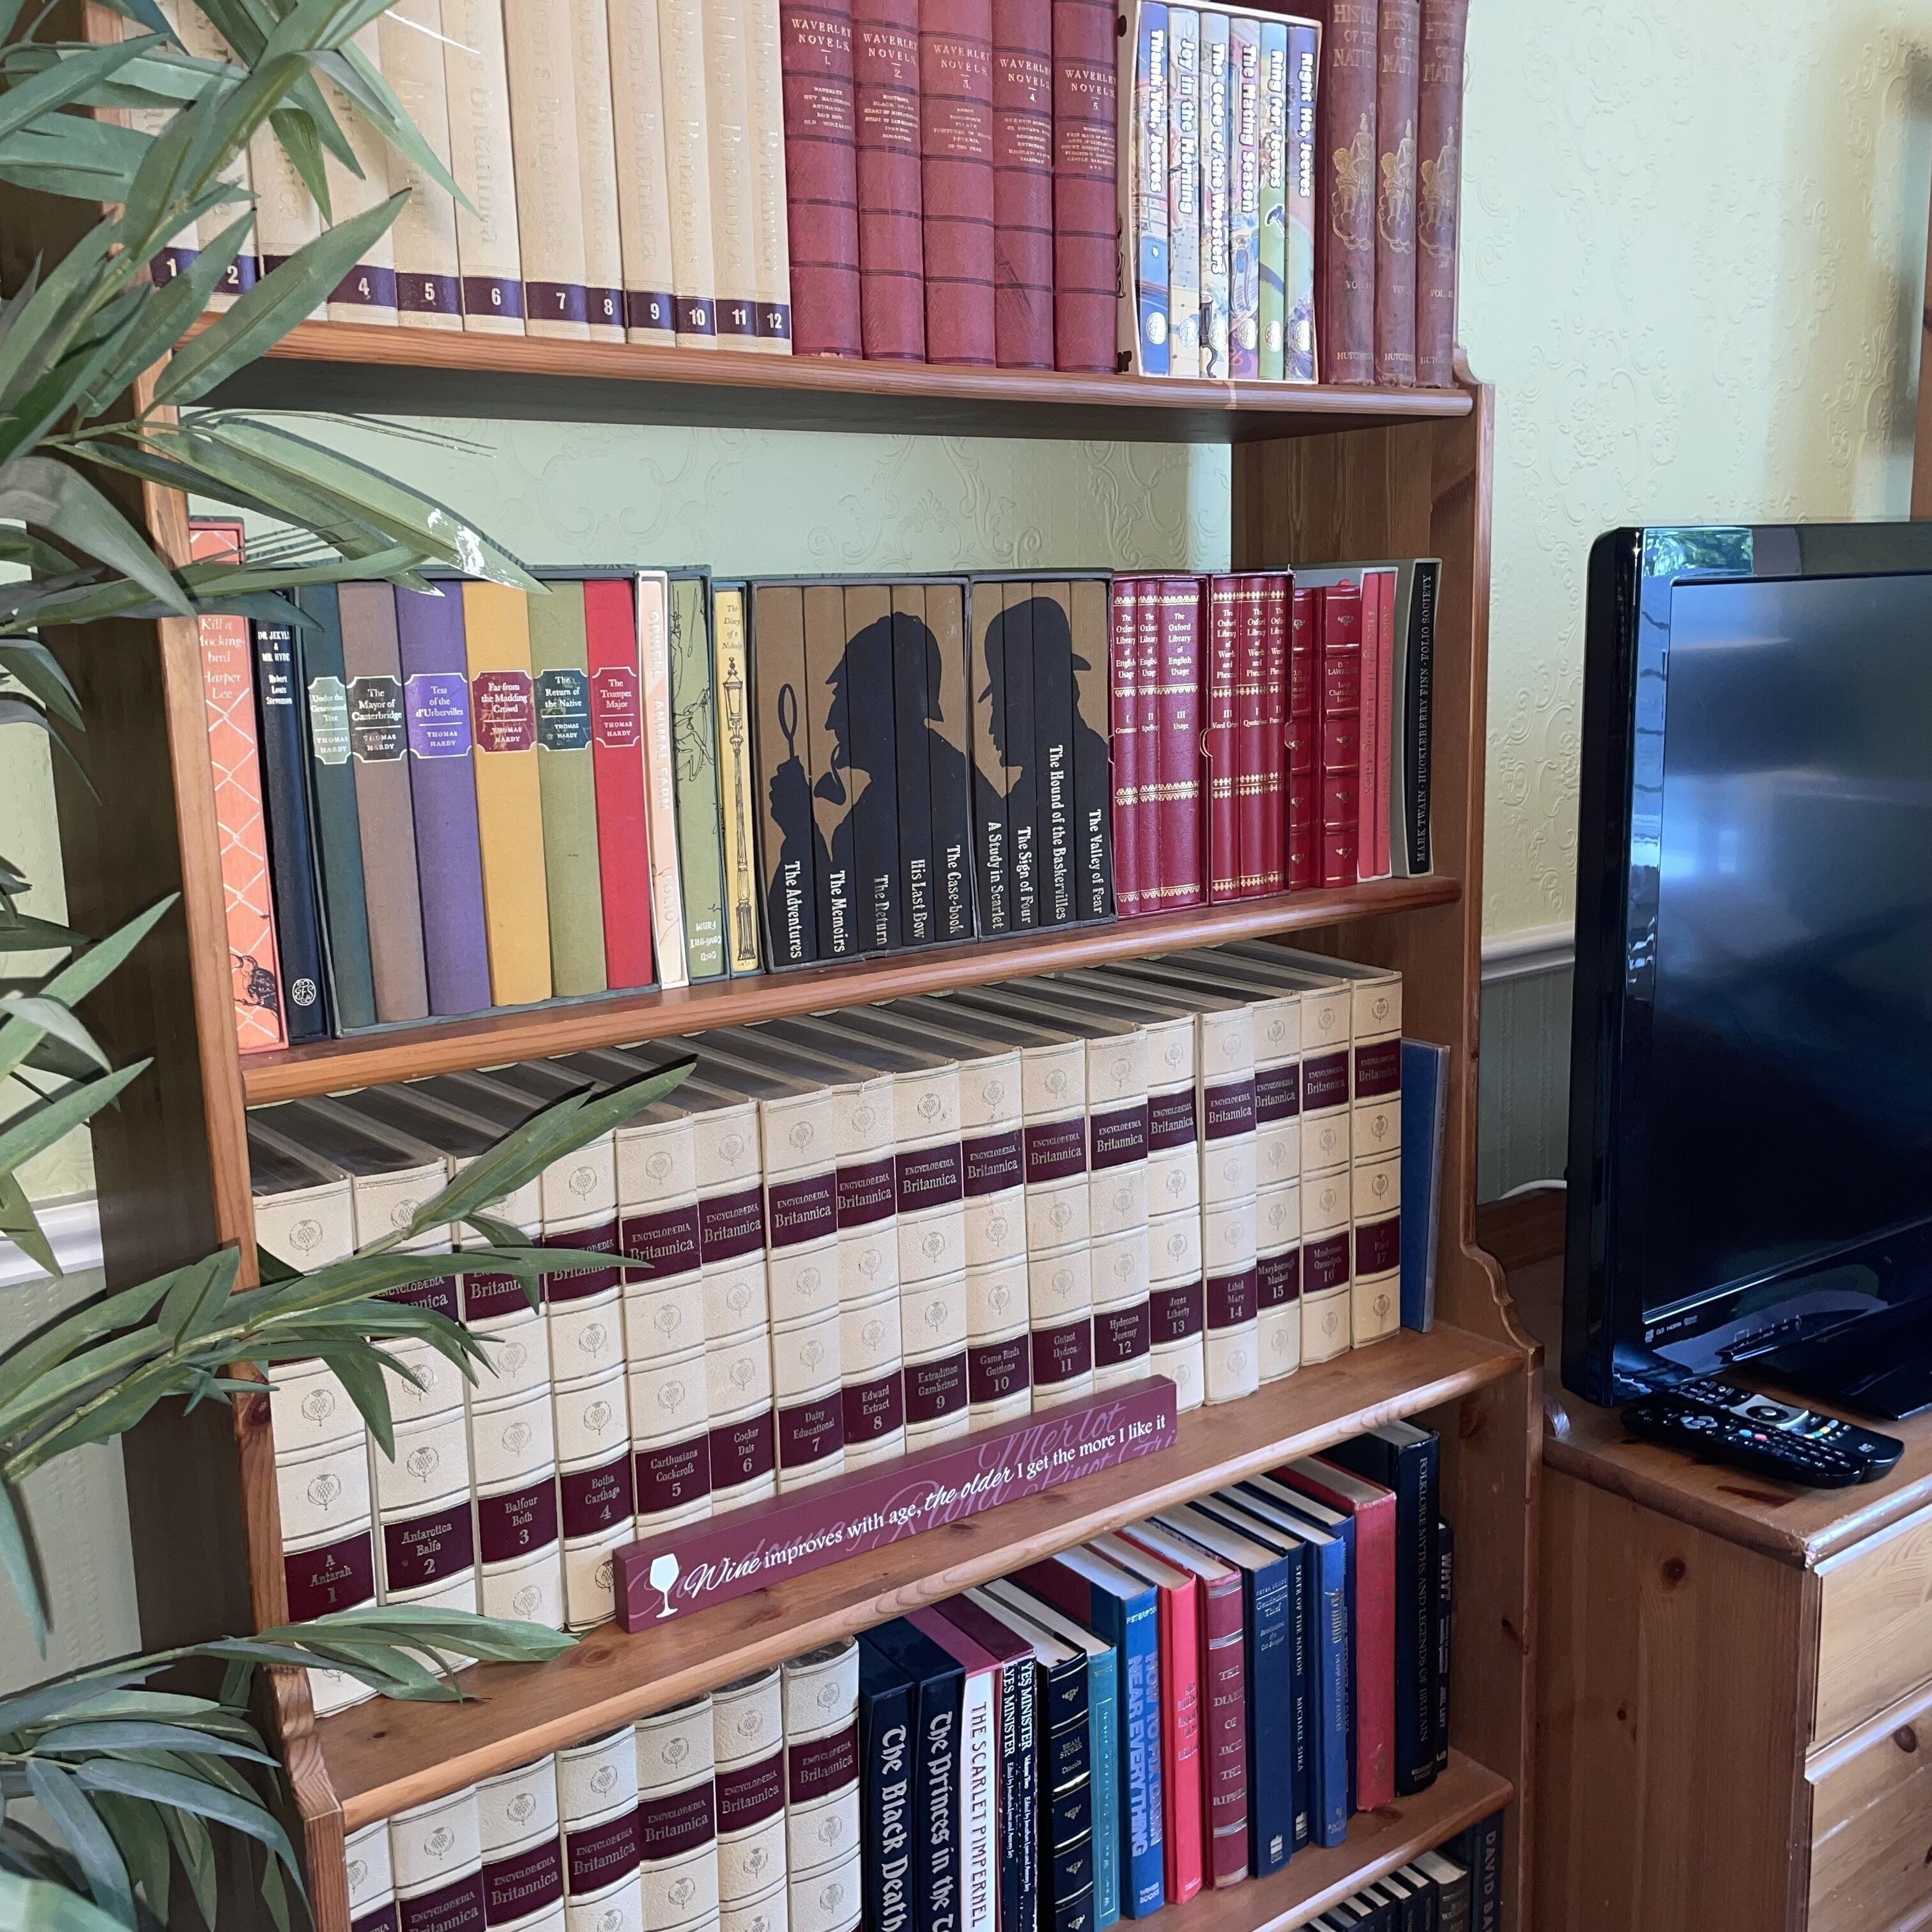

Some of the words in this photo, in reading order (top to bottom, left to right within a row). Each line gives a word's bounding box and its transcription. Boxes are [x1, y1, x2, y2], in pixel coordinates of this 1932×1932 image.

[792, 19, 851, 38] WAVERLEY
[1151, 29, 1164, 87] Thank
[1178, 38, 1195, 71] Joy
[1212, 43, 1225, 76] The
[1242, 45, 1257, 77] The
[1268, 50, 1284, 93] Ring
[1298, 52, 1313, 102] Right
[1181, 75, 1195, 95] in
[1149, 91, 1163, 128] You,
[1181, 98, 1195, 132] the
[1211, 82, 1225, 126] Code
[1239, 83, 1257, 146] Mating
[1270, 97, 1283, 127] for
[1298, 107, 1313, 137] Ho,
[1211, 132, 1225, 153] of
[1150, 134, 1163, 192] Jeeves
[1211, 155, 1225, 188] the
[1269, 131, 1282, 188] Jeeves
[1299, 141, 1312, 197] Jeeves
[1179, 137, 1195, 213] Morning
[1241, 151, 1255, 212] Season
[1211, 192, 1225, 275] Woosters
[555, 293, 566, 310] 7
[604, 300, 613, 316] 8
[650, 303, 659, 319] 9
[690, 309, 705, 325] 10
[732, 308, 746, 325] 11
[767, 312, 781, 329] 12
[727, 604, 737, 613] The
[1422, 574, 1432, 624] SOCIETY
[201, 618, 222, 631] Kill
[269, 631, 290, 640] JEKYLL
[208, 650, 231, 663] bird
[275, 653, 290, 661] HYDE
[1421, 629, 1430, 661] FOLIO
[269, 674, 288, 684] Robert
[555, 676, 569, 684] The
[1171, 668, 1190, 677] Usage
[1420, 668, 1429, 696] FINN
[212, 687, 233, 699] Lee
[367, 689, 385, 697] The
[431, 686, 447, 694] Tess
[489, 683, 501, 691] Far
[503, 683, 520, 691] from
[495, 693, 528, 703] Madding
[546, 688, 571, 696] Return
[572, 687, 580, 695] of
[601, 689, 632, 699] Trumpet
[358, 700, 385, 710] Mayor
[387, 699, 395, 708] of
[416, 708, 463, 717] d'Urbervilles
[429, 697, 438, 706] of
[493, 705, 519, 713] Crowd
[559, 699, 582, 707] Native
[606, 700, 628, 709] Major
[351, 710, 402, 721] Casterbridge
[1418, 699, 1429, 783] HUCKLEBERRY
[1049, 744, 1063, 767] The
[1050, 770, 1064, 809] Hound
[1052, 811, 1065, 823] of
[1417, 790, 1427, 825] TWAIN
[988, 822, 1002, 831] A
[1089, 809, 1101, 832] The
[1018, 826, 1031, 850] The
[1052, 825, 1066, 845] the
[1417, 827, 1426, 862] MARK
[947, 845, 960, 869] The
[987, 834, 1003, 868] Study
[1089, 834, 1102, 870] Valley
[785, 861, 800, 886] The
[910, 859, 926, 880] His
[990, 870, 1003, 883] in
[1016, 851, 1032, 878] Sign
[831, 870, 845, 895] The
[874, 875, 889, 899] The
[1020, 881, 1032, 893] of
[1053, 847, 1068, 920] Baskervilles
[1092, 872, 1104, 884] of
[911, 882, 926, 910] Last
[947, 871, 963, 933] Case-book
[991, 884, 1006, 929] Scarlet
[1092, 886, 1105, 914] Fear
[1020, 895, 1034, 923] Four
[786, 889, 802, 958] Adventures
[831, 898, 848, 953] Memoirs
[875, 901, 889, 946] Return
[913, 912, 928, 938] Bow
[838, 1188, 891, 1210] Britannica
[705, 1218, 762, 1243] Britannica
[1229, 1305, 1243, 1319] 14
[793, 1416, 835, 1440] Educational
[979, 1402, 1127, 1470] Merlot
[811, 1438, 820, 1452] 7
[656, 1462, 695, 1482] Cockcroft
[671, 1482, 682, 1498] 5
[505, 1496, 538, 1514] Balfour
[683, 1557, 762, 1598] Wine
[764, 1531, 843, 1568] improves
[847, 1514, 884, 1541] with
[889, 1503, 921, 1525] age,
[925, 1485, 958, 1510] the
[961, 1467, 1015, 1498] older
[1017, 1463, 1023, 1478] I
[1027, 1457, 1049, 1480] get
[1053, 1448, 1076, 1466] the
[1079, 1435, 1116, 1457] more
[1119, 1427, 1126, 1443] I
[1128, 1420, 1153, 1440] like
[1156, 1414, 1166, 1430] it
[512, 1512, 533, 1527] Both
[519, 1529, 530, 1545] 3
[1296, 1598, 1302, 1609] OF
[1020, 1660, 1034, 1687] YES
[1128, 1655, 1144, 1721] NEAR
[970, 1701, 986, 1738] THE
[1020, 1688, 1034, 1751] MINISTER
[927, 1711, 953, 1754] The
[881, 1726, 907, 1774] The
[970, 1738, 987, 1821] SCARLET
[1129, 1721, 1147, 1857] EVERYTHING
[645, 1814, 709, 1841] Britannica
[882, 1778, 908, 1854] Black
[931, 1846, 954, 1874] in
[970, 1825, 987, 1928] PIMPERNEL
[881, 1853, 908, 1932] Death
[930, 1875, 953, 1912] the
